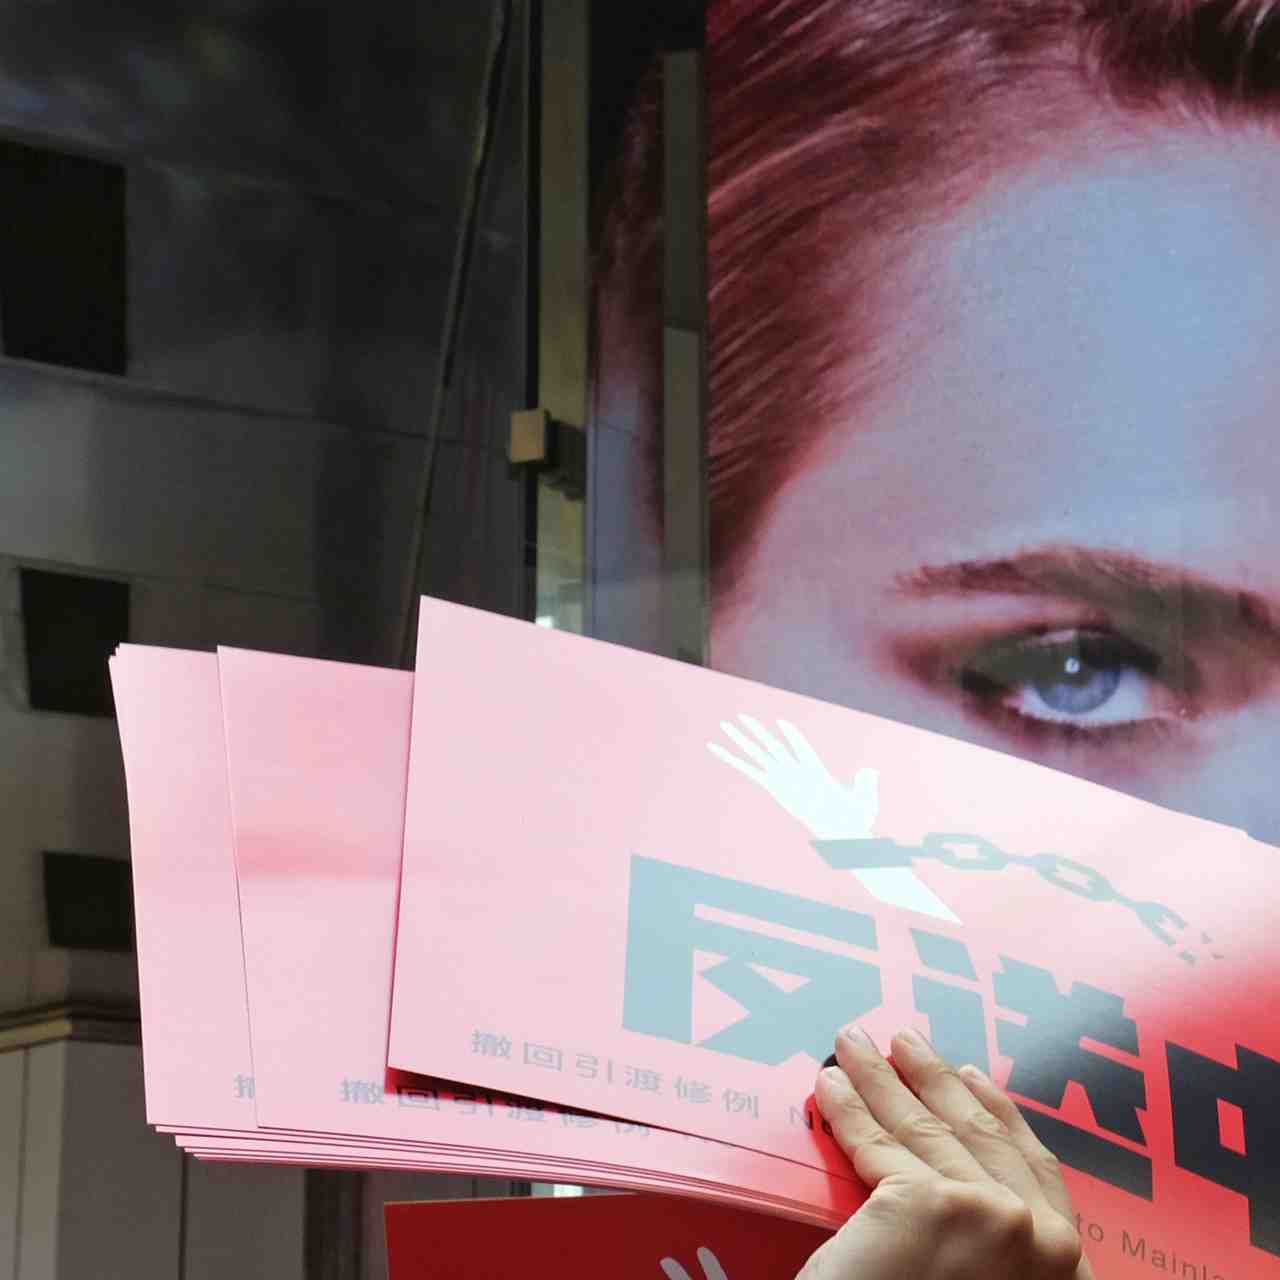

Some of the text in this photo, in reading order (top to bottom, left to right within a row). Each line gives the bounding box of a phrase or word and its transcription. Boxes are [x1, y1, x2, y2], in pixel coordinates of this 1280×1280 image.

[471, 1028, 761, 1121] 撤回引渡修例
[1076, 1211, 1105, 1243] to
